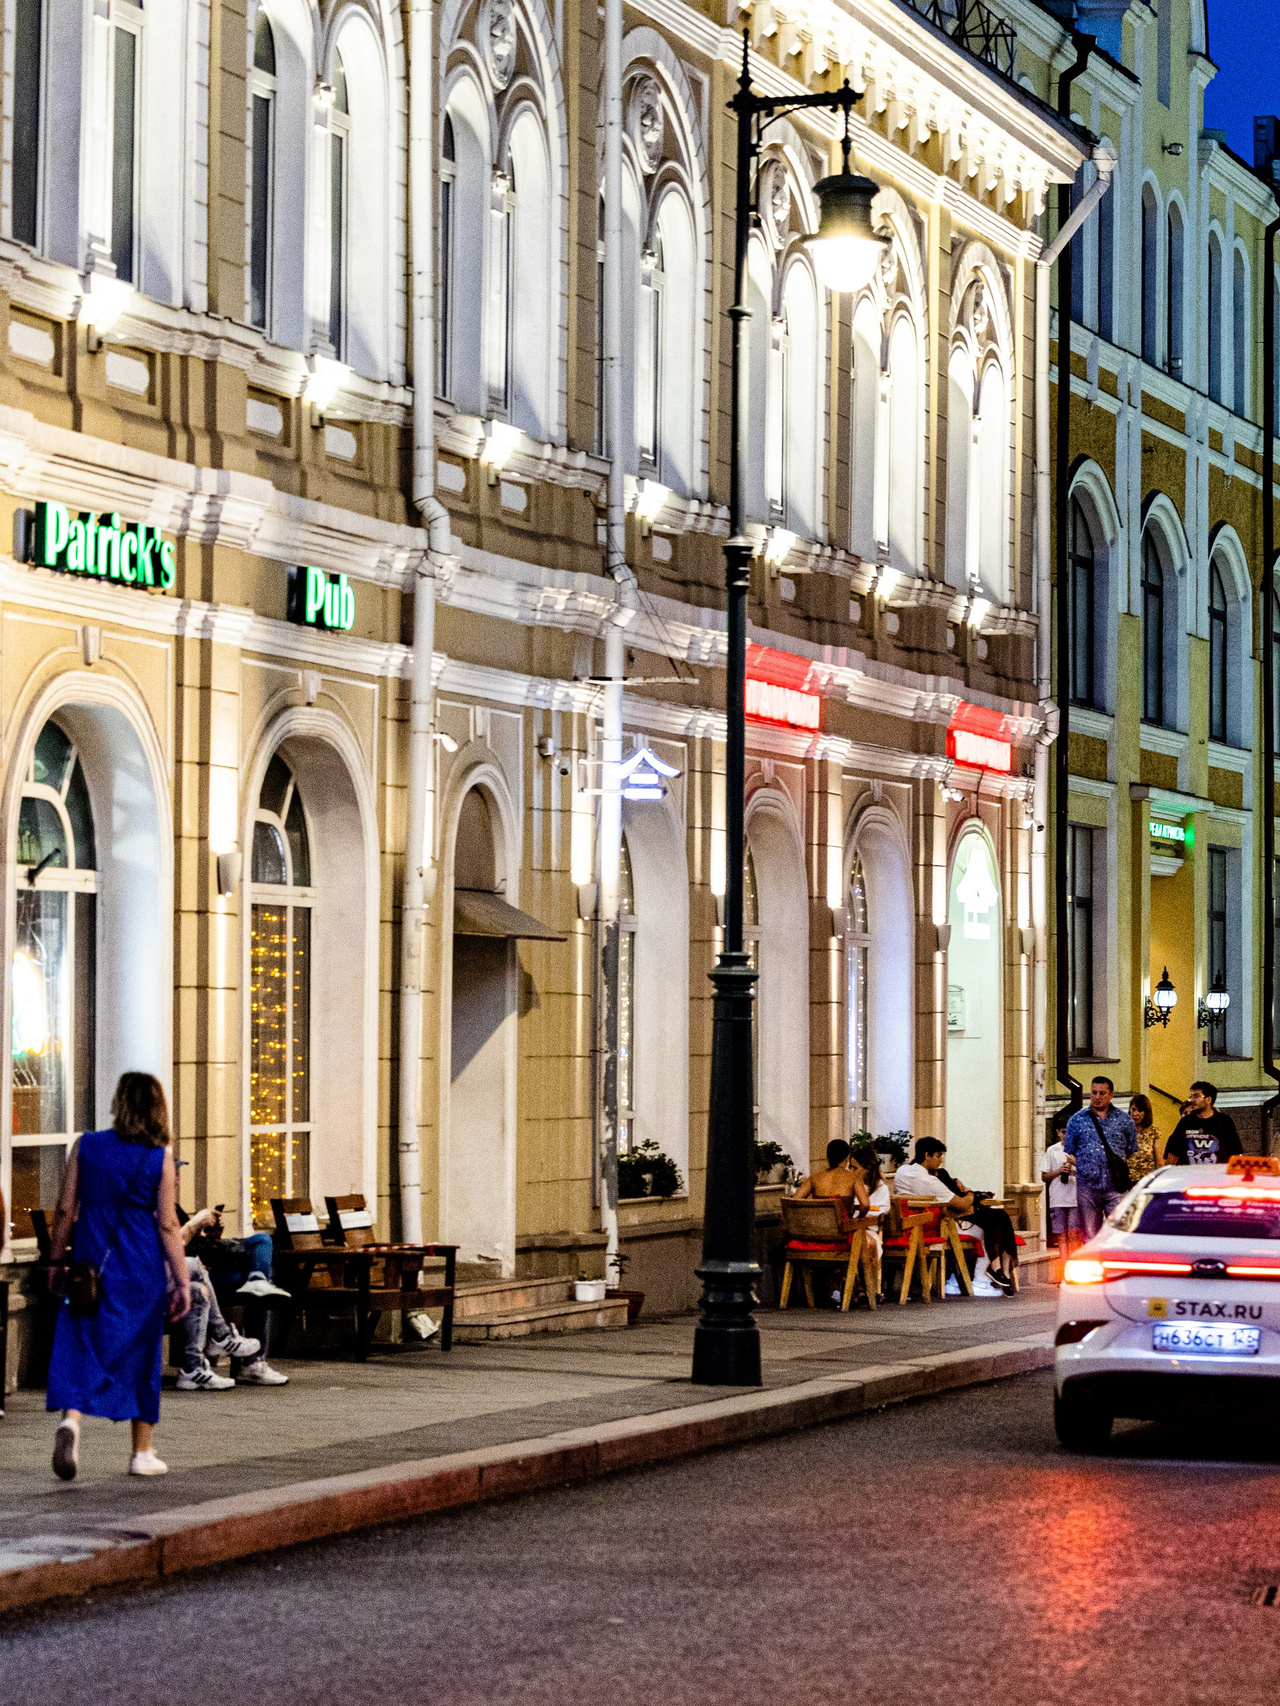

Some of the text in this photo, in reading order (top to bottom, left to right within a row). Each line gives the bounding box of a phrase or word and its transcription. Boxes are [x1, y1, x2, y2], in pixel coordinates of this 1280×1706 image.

[45, 501, 356, 631] Patrick's Pub
[1175, 1301, 1263, 1320] STAX.RU
